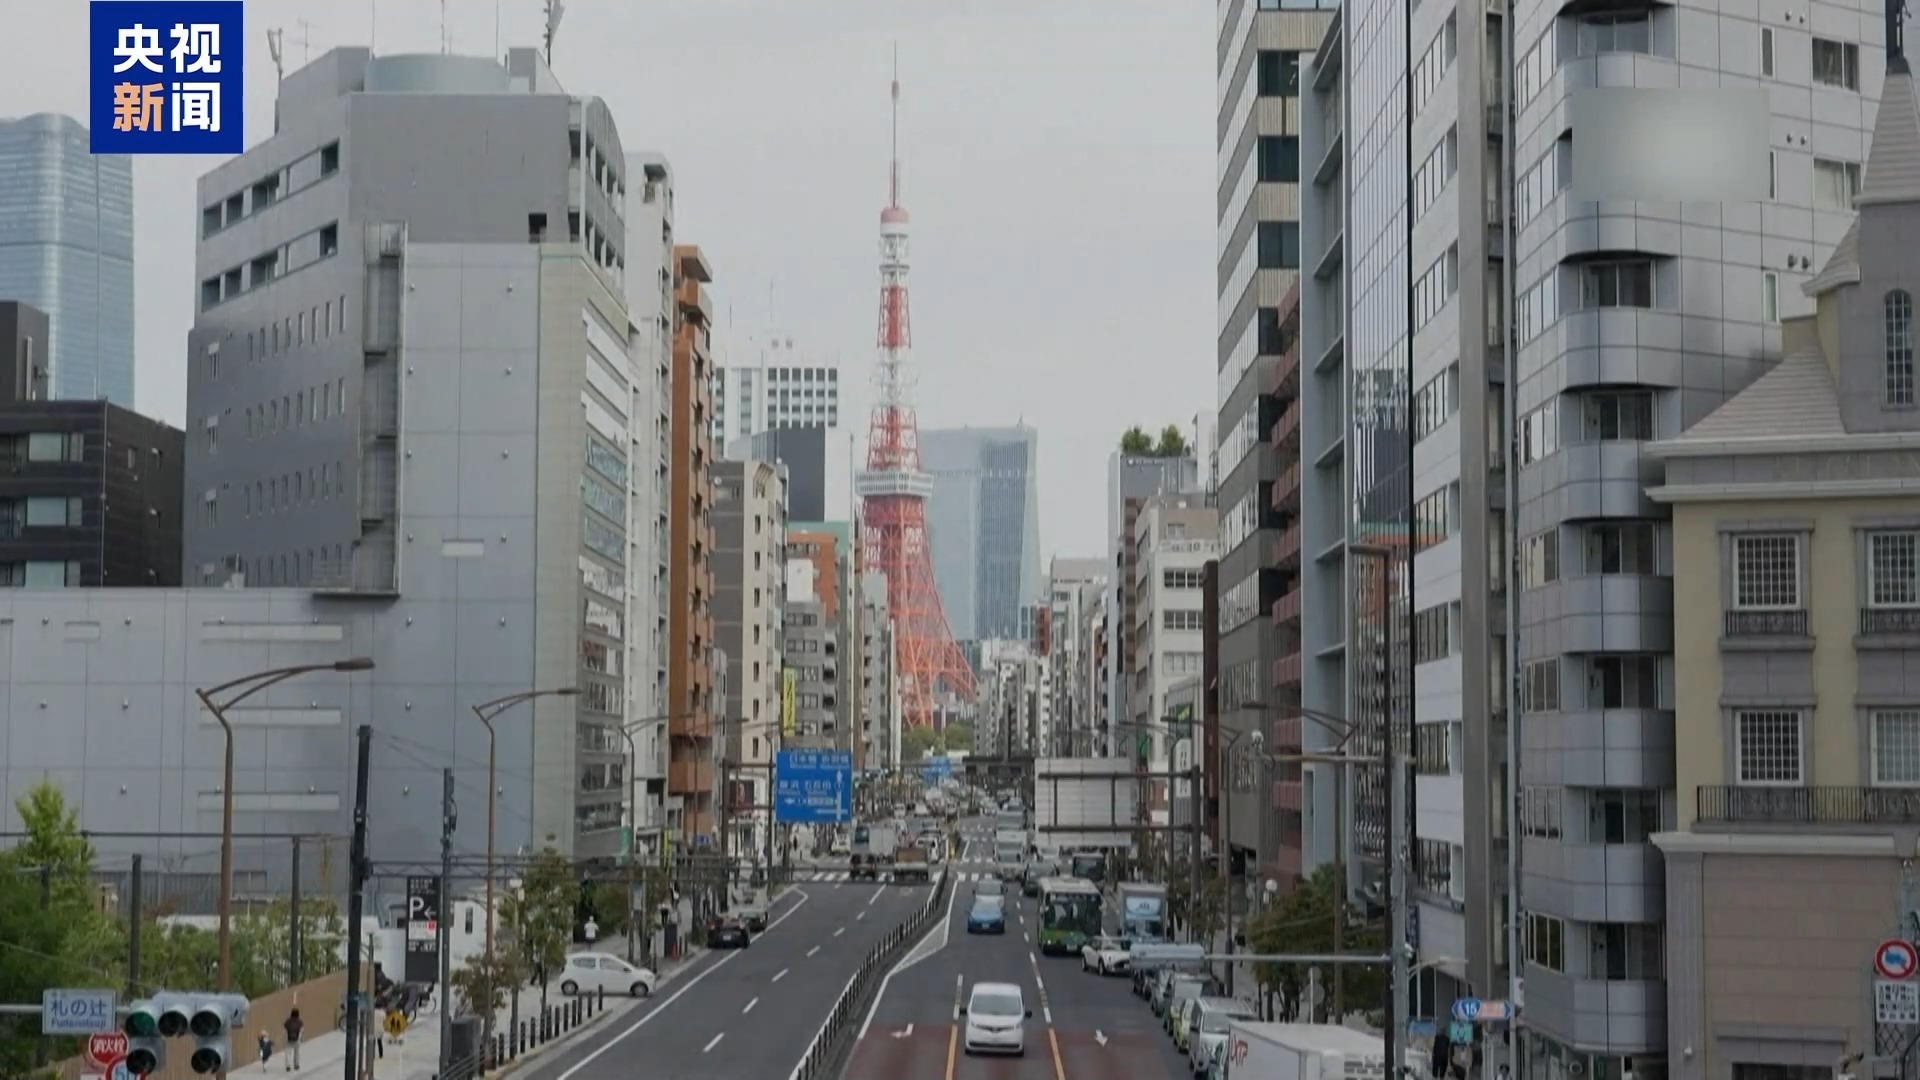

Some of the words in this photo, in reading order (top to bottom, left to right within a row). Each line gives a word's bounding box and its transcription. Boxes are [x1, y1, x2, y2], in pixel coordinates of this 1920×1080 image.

[409, 896, 425, 920] P
[51, 999, 107, 1018] 札の辻
[1464, 1003, 1478, 1015] 15
[51, 1018, 106, 1029] Fudanotsuji
[93, 1038, 125, 1053] 消火栓
